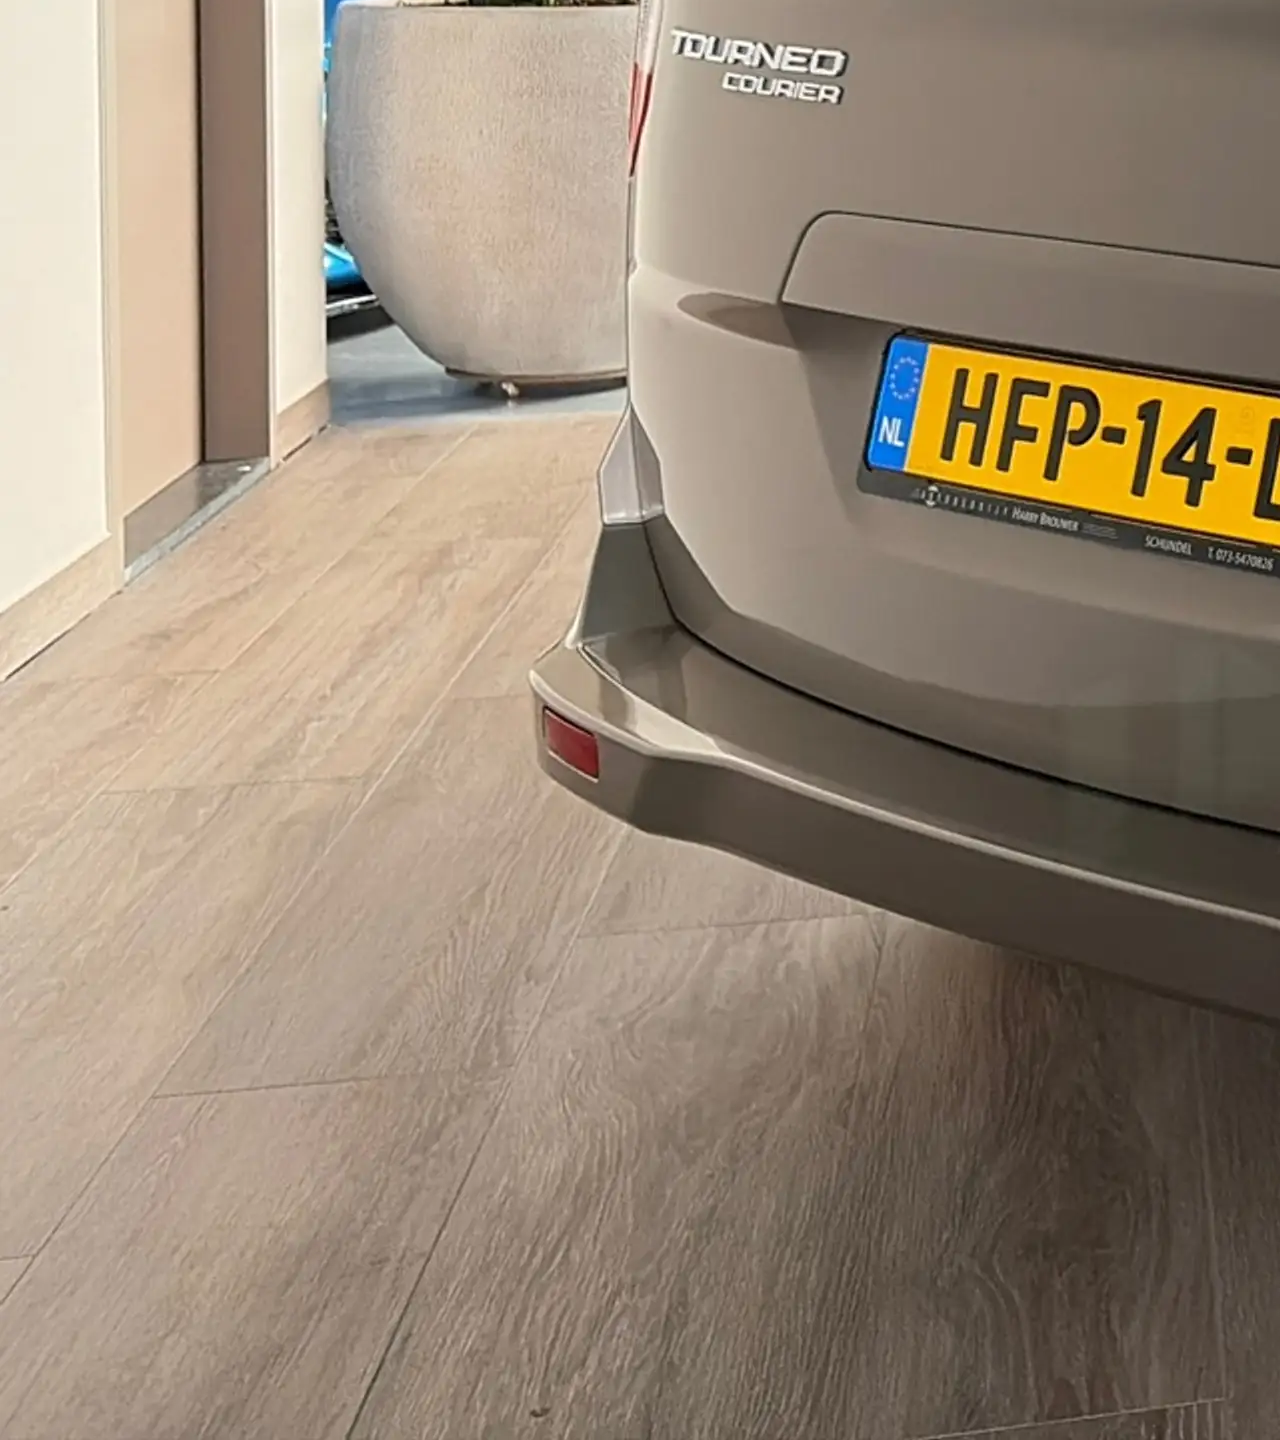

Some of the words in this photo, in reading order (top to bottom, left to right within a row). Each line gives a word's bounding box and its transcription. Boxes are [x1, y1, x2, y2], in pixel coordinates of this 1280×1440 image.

[670, 29, 847, 76] TOURNEO
[722, 71, 842, 104] COURIER
[878, 415, 905, 448] NL
